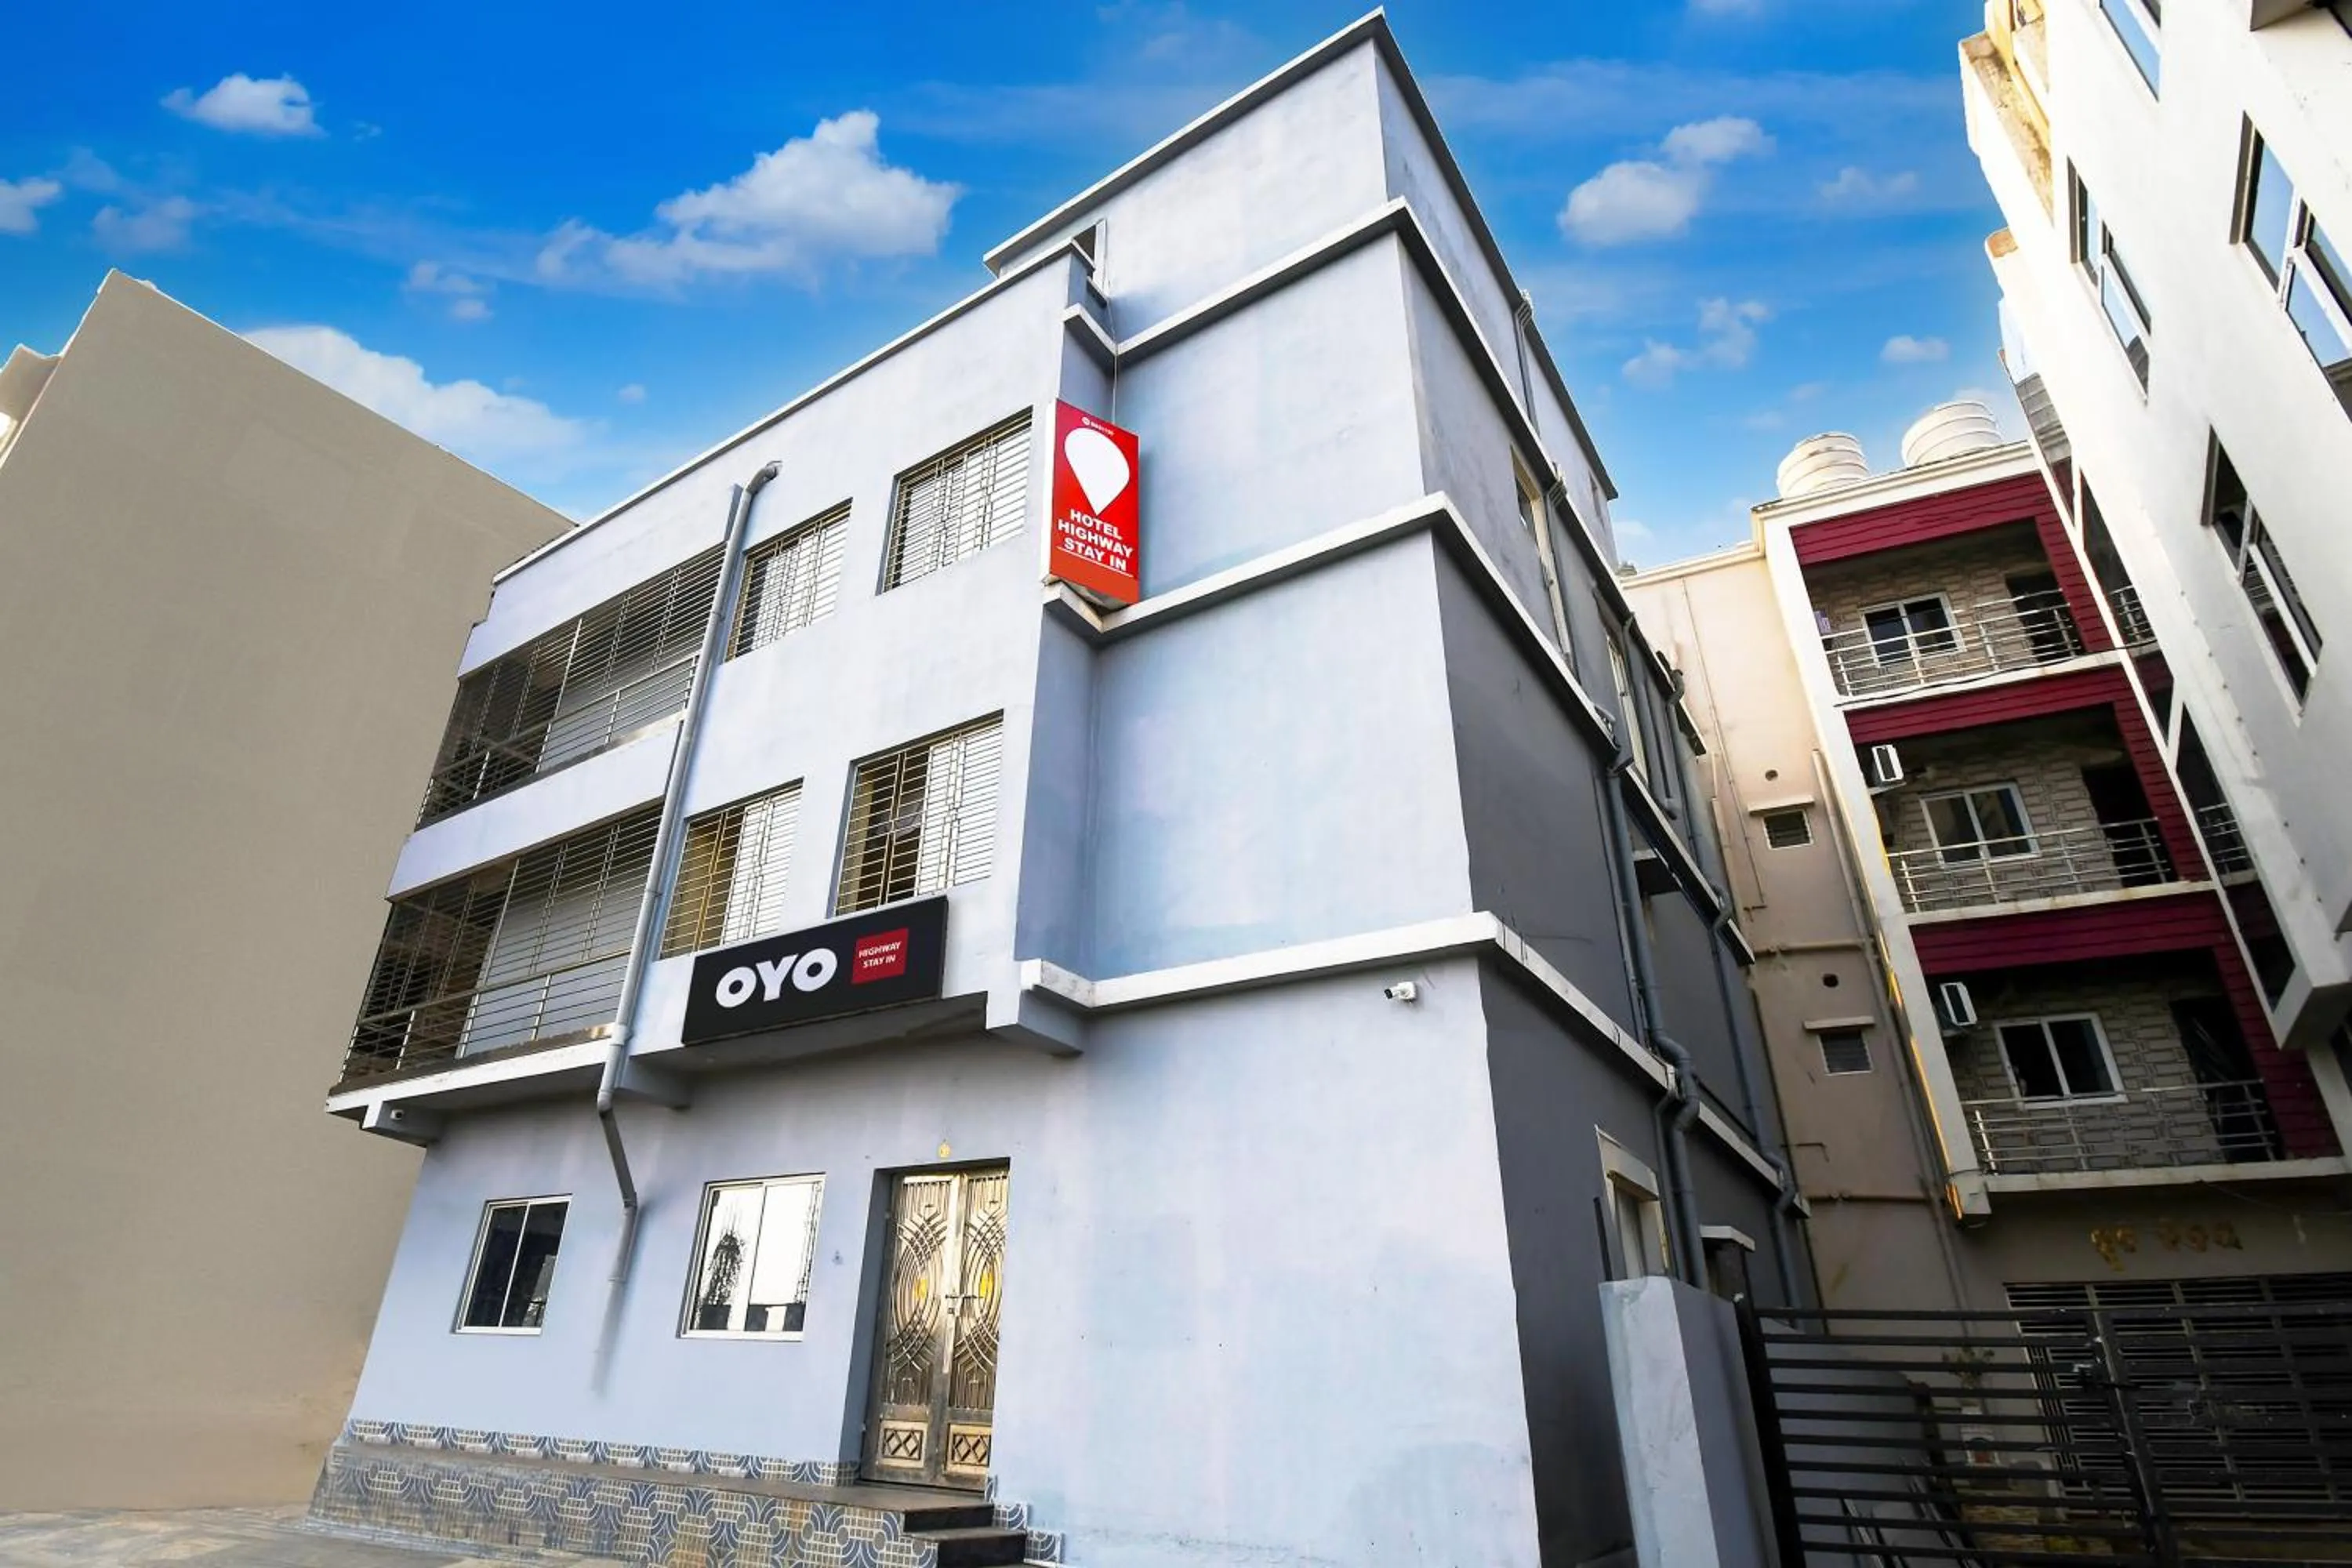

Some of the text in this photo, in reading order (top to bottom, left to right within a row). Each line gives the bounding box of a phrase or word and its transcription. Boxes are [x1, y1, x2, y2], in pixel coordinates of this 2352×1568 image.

[1058, 519, 1133, 559] HIGHWAY
[1070, 509, 1123, 540] HOTEL
[1064, 537, 1127, 572] STAY IN
[858, 941, 902, 958] HIGHWAY
[862, 954, 896, 968] STAY IN
[715, 947, 838, 1008] OYO
